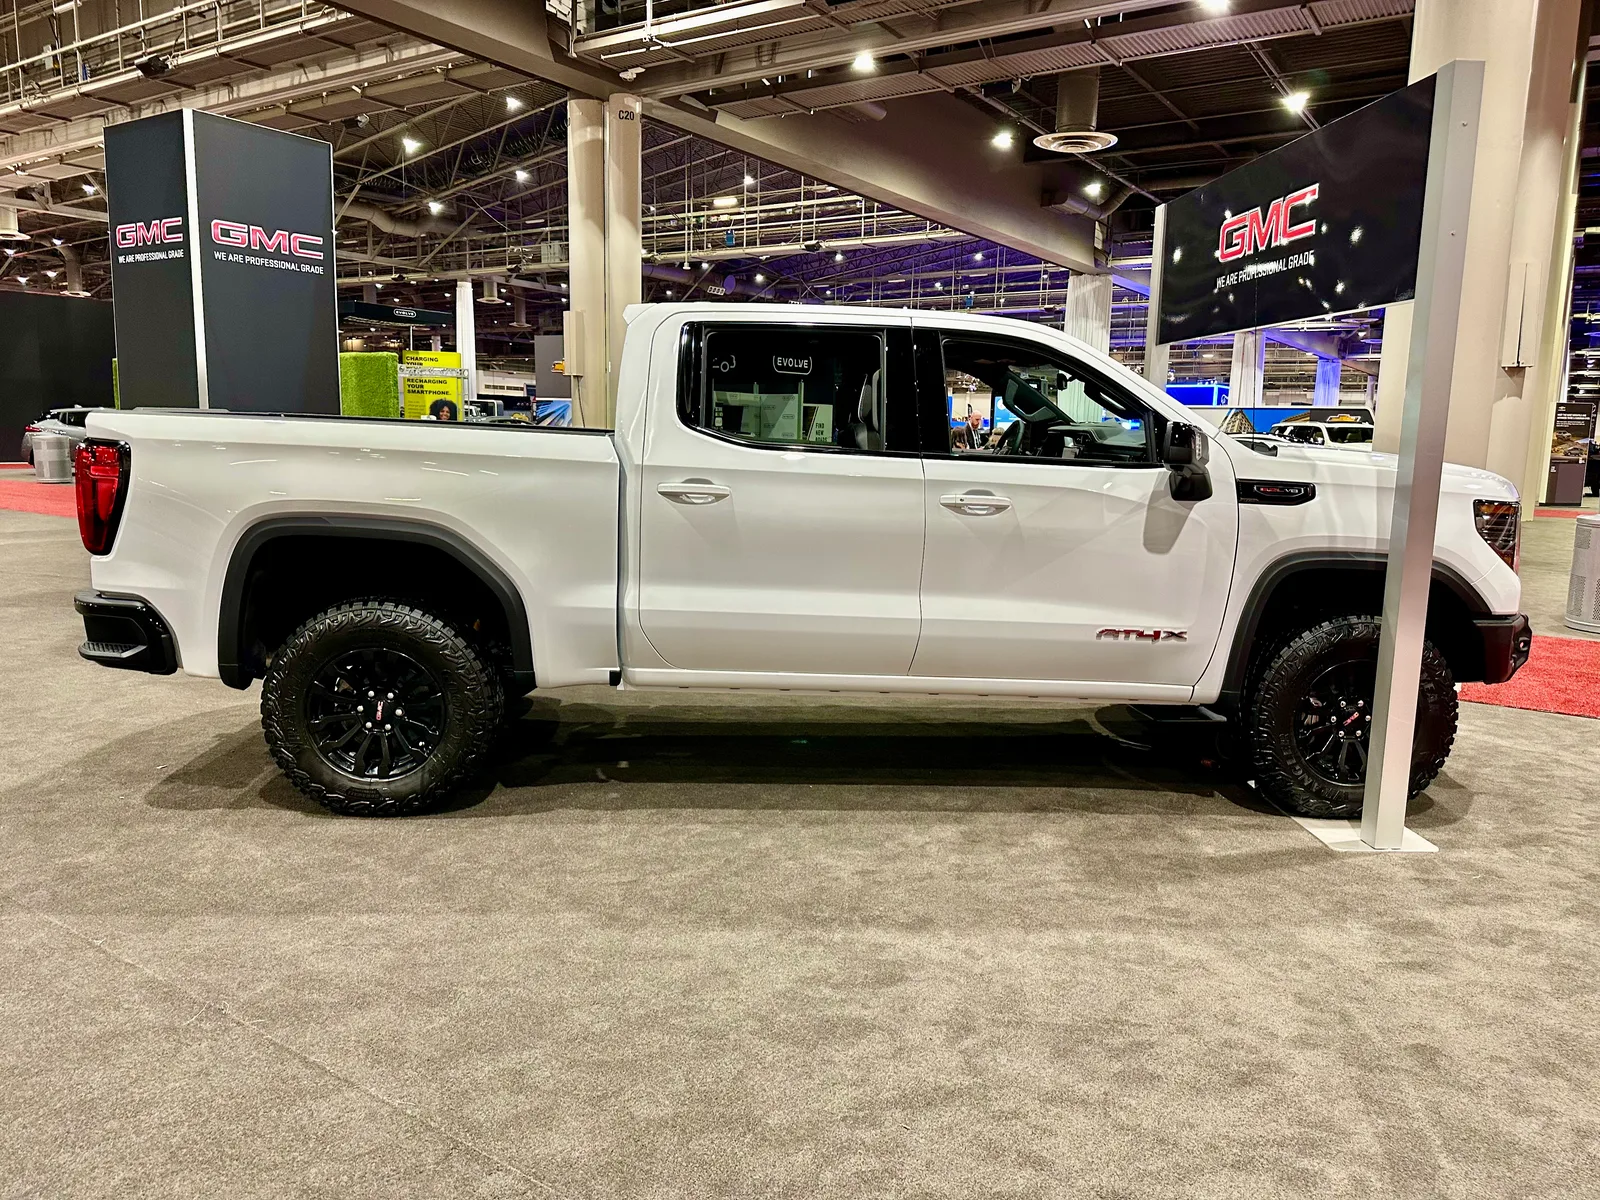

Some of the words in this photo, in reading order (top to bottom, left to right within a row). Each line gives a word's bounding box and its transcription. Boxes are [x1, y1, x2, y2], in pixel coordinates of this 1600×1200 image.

[618, 110, 635, 121] C20
[116, 216, 183, 248] GMC
[1219, 183, 1319, 263] GMC
[211, 219, 324, 260] GMC
[118, 254, 126, 264] WE
[126, 254, 135, 263] ARE
[135, 251, 168, 262] PROFESSIONAL
[168, 249, 184, 259] GRADE
[214, 250, 227, 261] WE
[228, 253, 244, 264] ARE
[245, 255, 300, 272] PROFESSIONAL
[301, 263, 324, 275] GRADE
[1216, 275, 1226, 289] WE
[1226, 271, 1238, 287] ARE
[1238, 257, 1287, 283] PROFESSIONAL
[1288, 250, 1315, 269] GRADE
[777, 357, 809, 369] EVOLVE
[1096, 628, 1187, 644] AT4X
